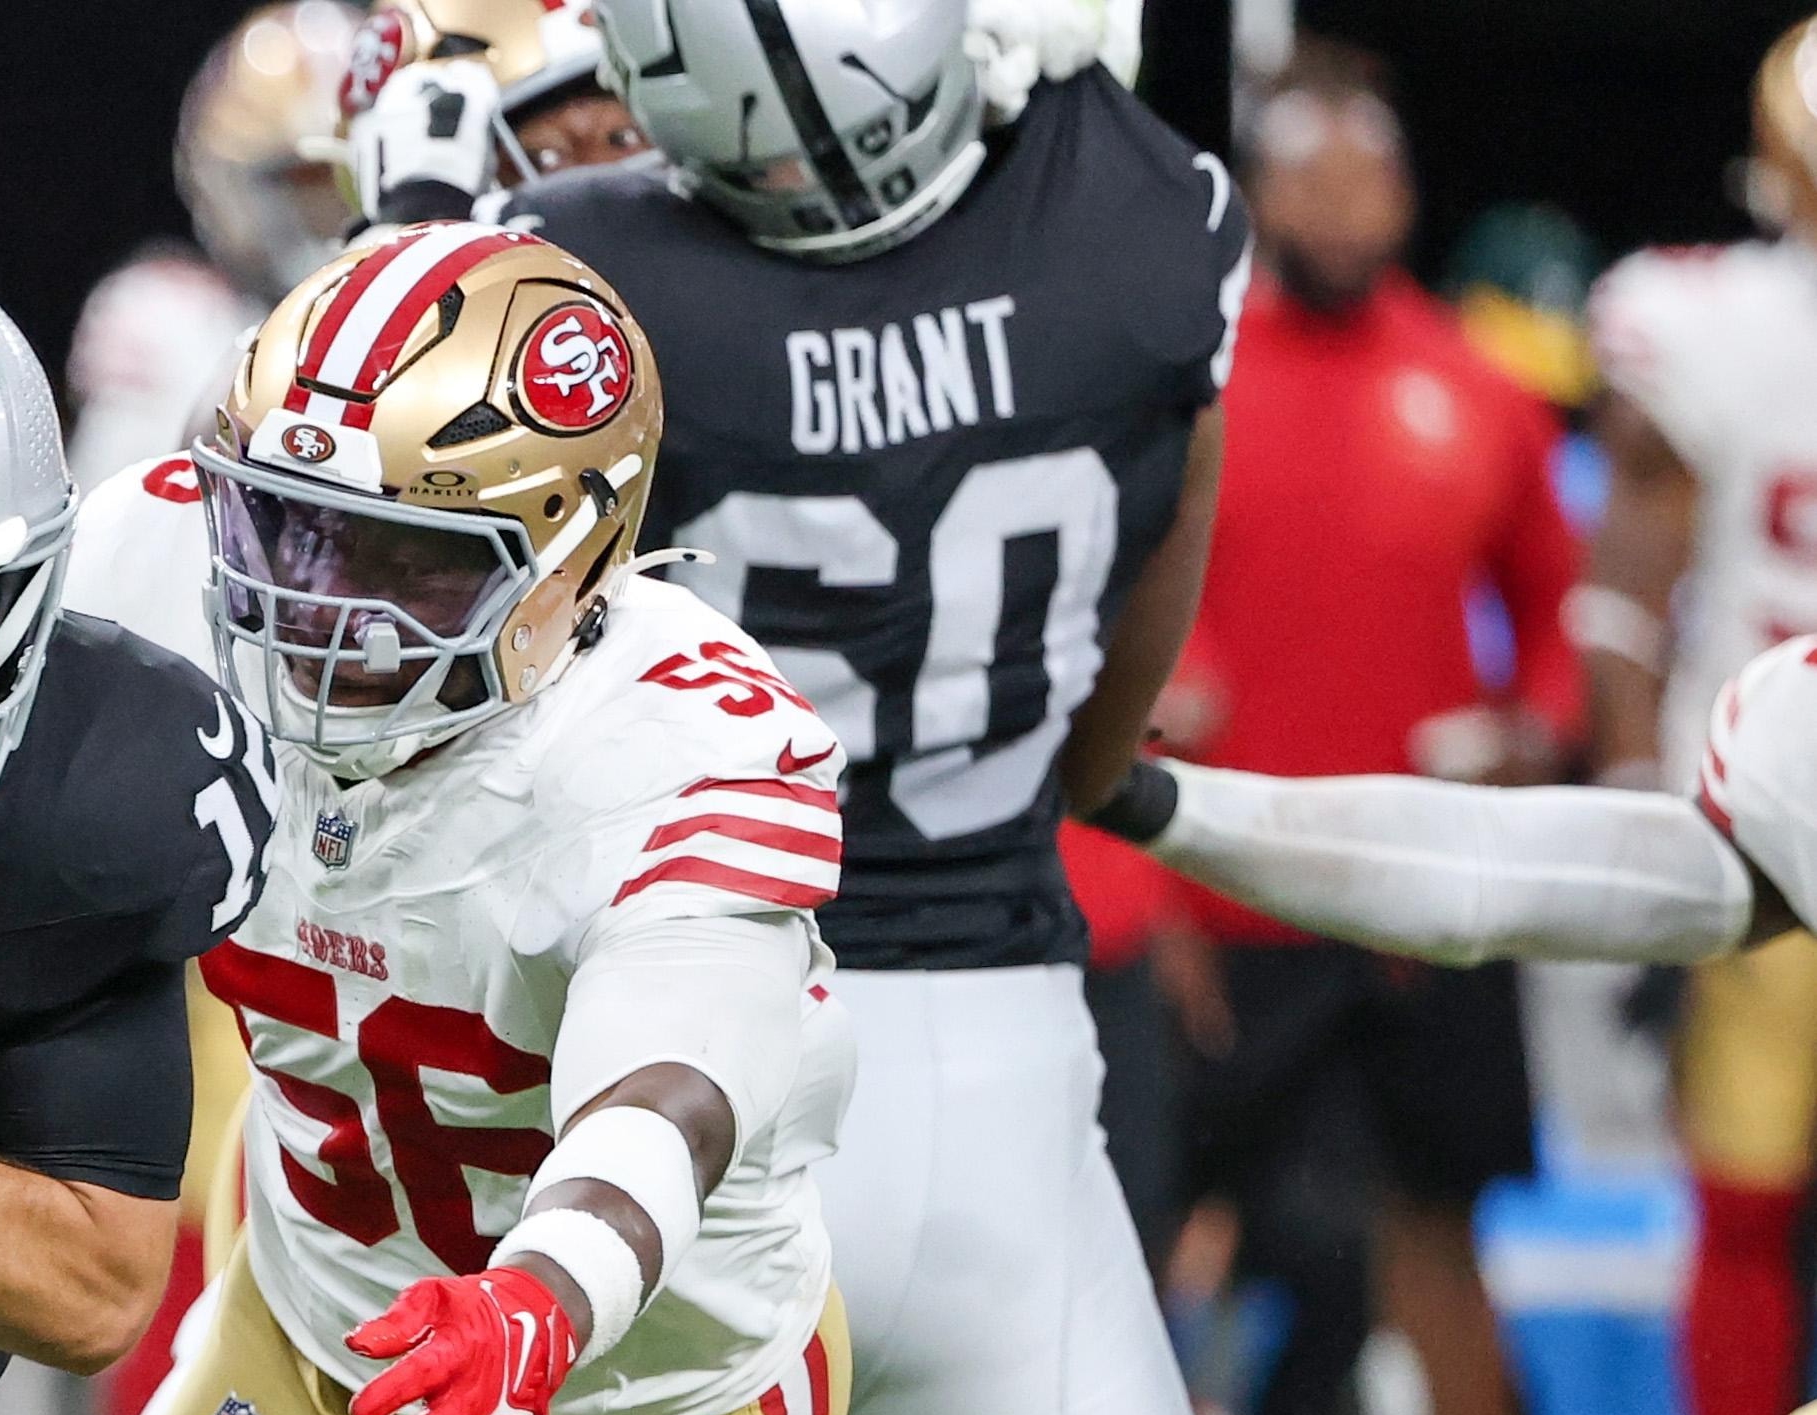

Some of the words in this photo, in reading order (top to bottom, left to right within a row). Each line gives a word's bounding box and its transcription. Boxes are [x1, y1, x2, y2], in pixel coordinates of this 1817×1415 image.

[785, 294, 1016, 455] GRANT
[666, 446, 1120, 841] 60
[315, 834, 344, 863] NFL
[198, 936, 556, 1278] 56
